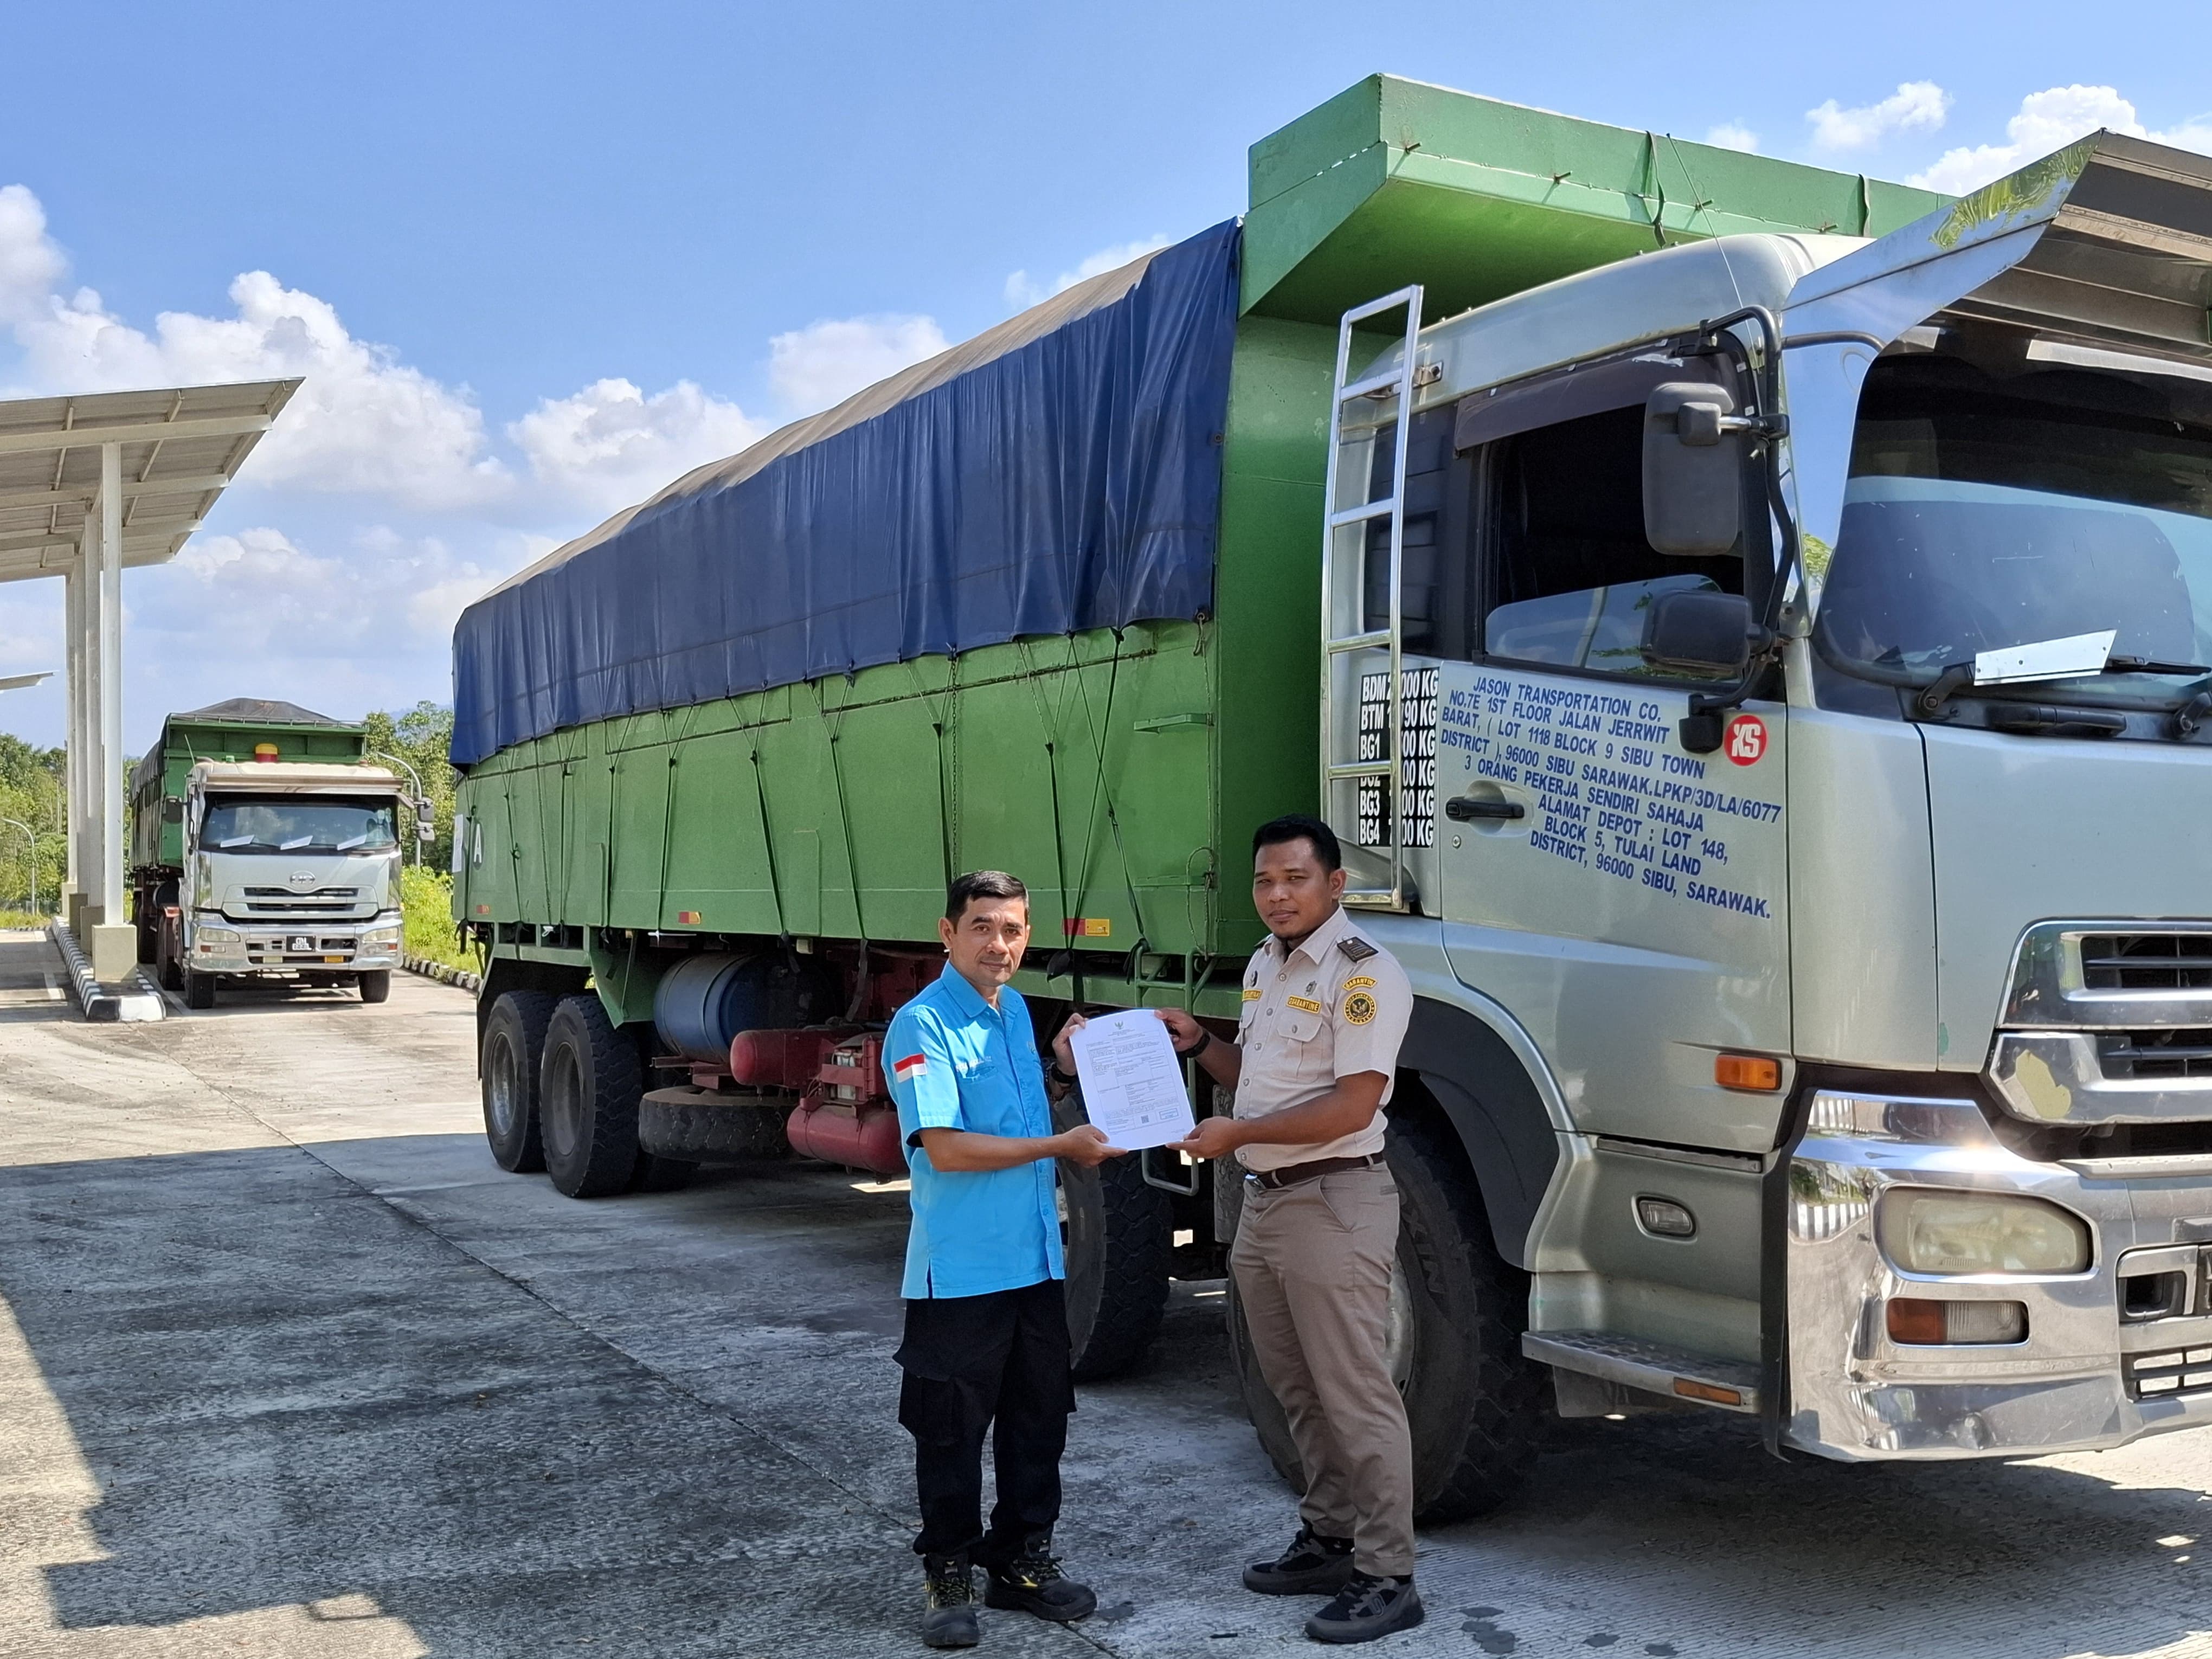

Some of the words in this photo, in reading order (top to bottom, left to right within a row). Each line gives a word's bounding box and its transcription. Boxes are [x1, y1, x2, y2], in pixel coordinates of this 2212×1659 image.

[1362, 675, 1386, 702] BDM
[1422, 670, 1438, 697] KG
[1474, 677, 1511, 698] JASON
[1518, 684, 1631, 717] TRANSPORTATION
[1638, 702, 1661, 722] CO.
[1361, 704, 1384, 730] BTM
[1419, 698, 1437, 726] KG
[1449, 690, 1481, 710] NO.7E
[1487, 697, 1507, 715] 1ST
[1512, 702, 1552, 724] FLOOR
[1559, 710, 1601, 732] JALAN
[1607, 718, 1670, 744] JERRWIT
[1360, 732, 1380, 760] BG1
[1418, 729, 1436, 757] KG
[1441, 729, 1490, 755] DISTRICT
[1505, 744, 1539, 767] 96000
[1546, 755, 1575, 776] SIBU
[1442, 706, 1480, 733] BARAT,
[1498, 719, 1521, 739] LOT
[1528, 726, 1551, 746] 1118
[1554, 732, 1598, 756] BLOCK
[1605, 742, 1613, 759] 9
[1621, 746, 1654, 768] SIBU
[1662, 754, 1706, 780] TOWN
[1418, 760, 1435, 787] KG
[1464, 755, 1471, 770] 3
[1477, 758, 1517, 782] ORANG
[1524, 770, 1579, 800] PEKERJA
[1587, 786, 1640, 815] SENDIRI
[1647, 801, 1703, 832] SAHAJA
[1360, 790, 1380, 816] BG3
[1417, 789, 1435, 816] KG
[473, 824, 482, 863] A
[1360, 818, 1380, 845] BG4
[1416, 819, 1433, 846] KG
[1538, 794, 1591, 823] ALAMAT
[1597, 811, 1642, 837] DEPOT
[1662, 828, 1691, 851] LOT
[1701, 838, 1728, 866] 148,
[1545, 815, 1588, 843] BLOCK
[1594, 831, 1605, 852] 5,
[1615, 835, 1655, 863] TULAI
[1661, 850, 1701, 876] LAND
[1530, 830, 1588, 868] DISTRICT,
[1596, 853, 1635, 880] 96000
[1642, 868, 1677, 898] SIBU,
[1686, 881, 1771, 919] SARAWAK.
